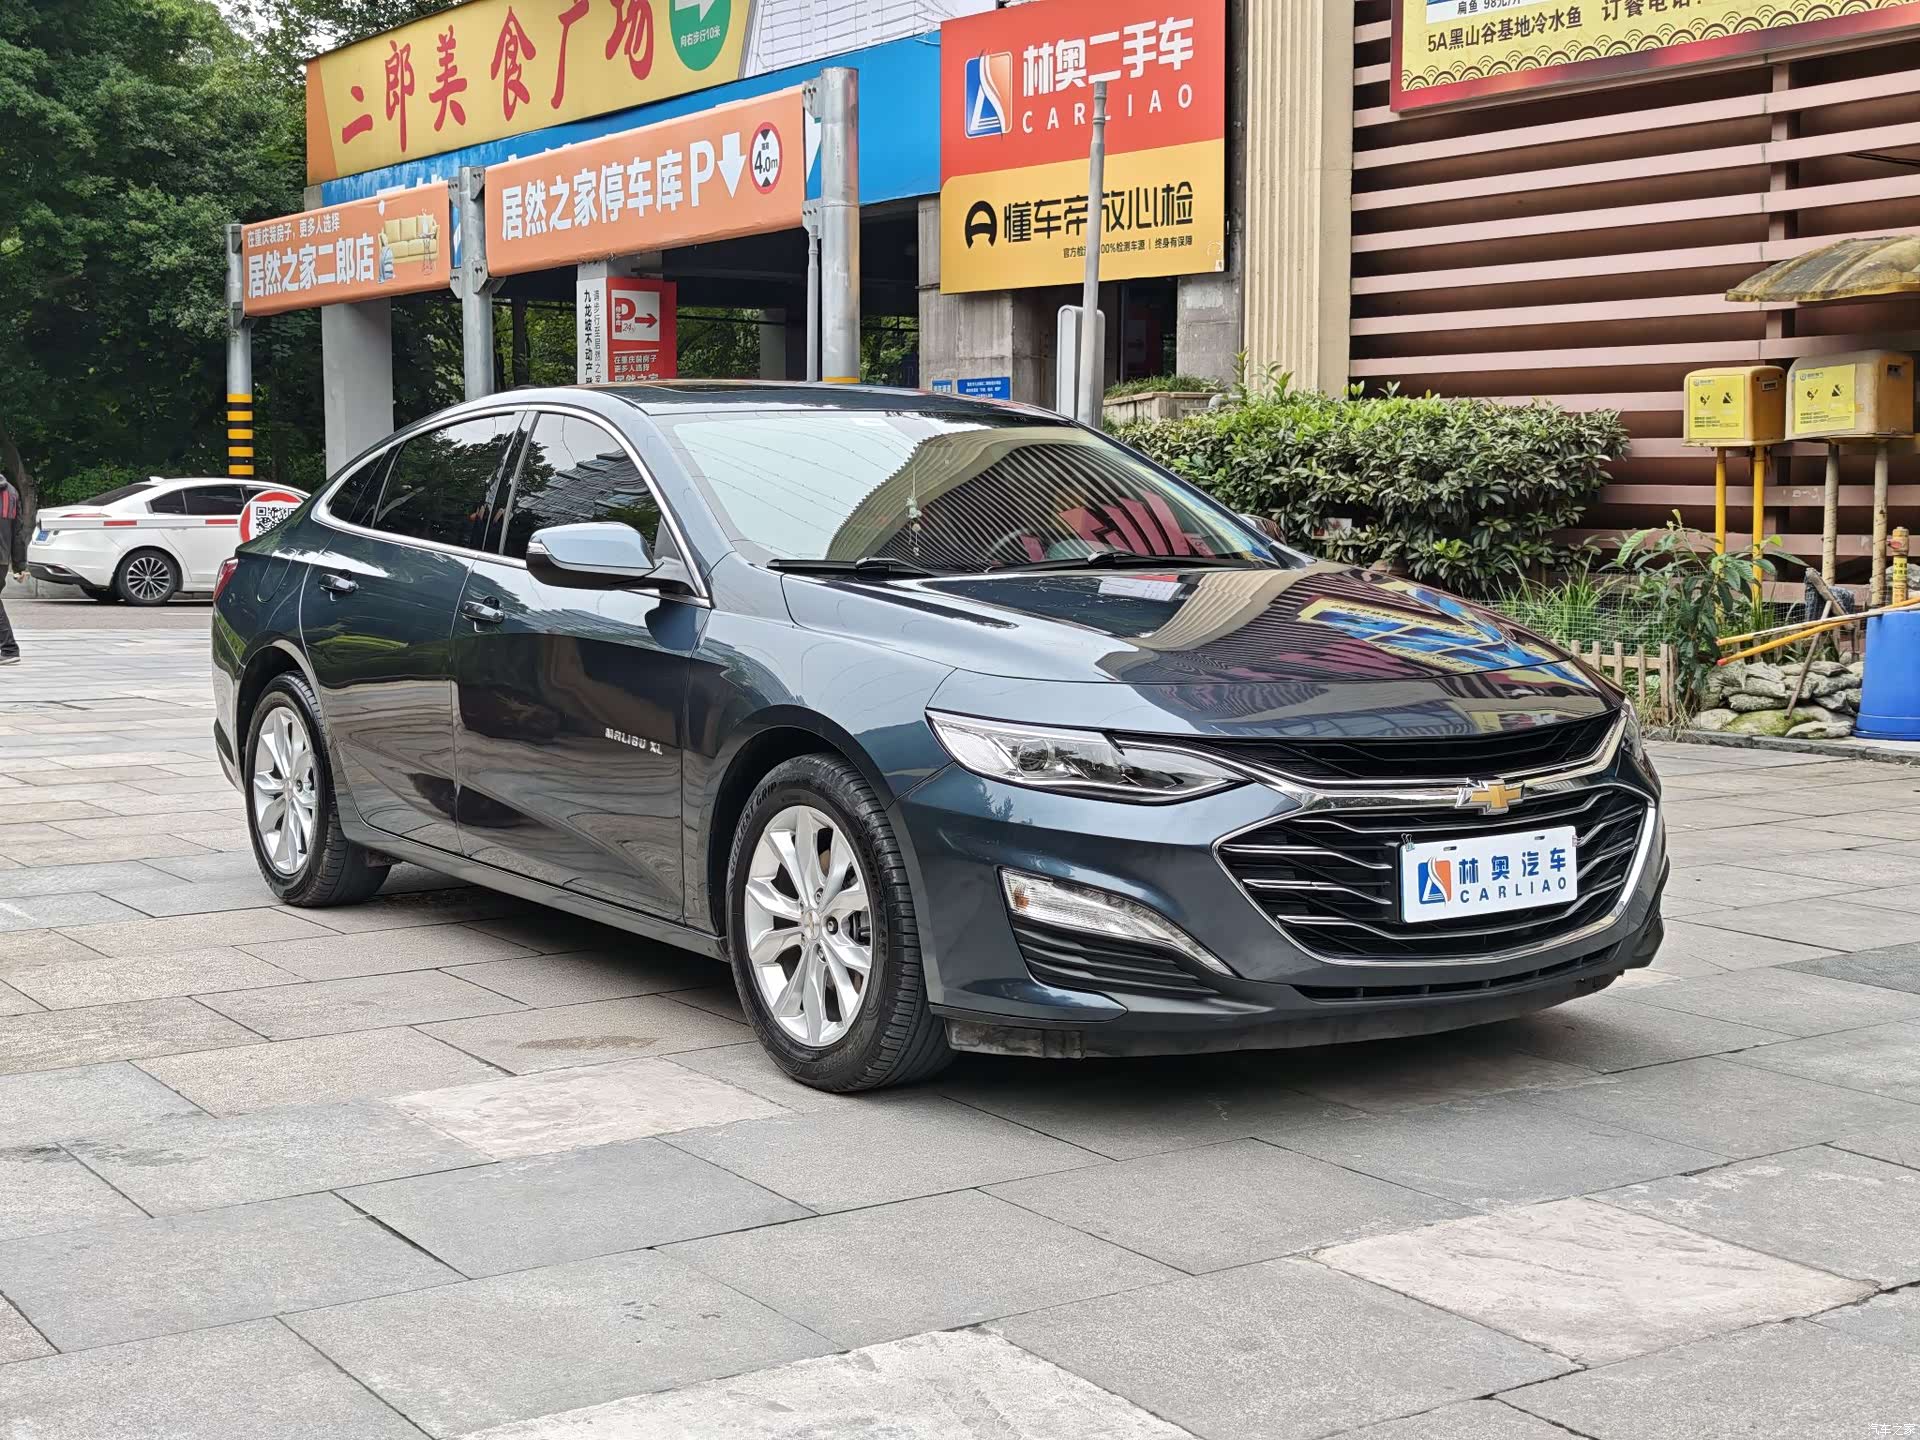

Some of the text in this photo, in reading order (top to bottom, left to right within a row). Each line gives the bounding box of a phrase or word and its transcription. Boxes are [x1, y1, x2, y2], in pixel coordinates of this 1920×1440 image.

[680, 25, 721, 47] 向右步行10米
[1428, 6, 1583, 52] 5A黑山谷基地冷水鱼
[342, 0, 654, 152] 二郎美食广场
[1023, 17, 1194, 97] 林奥二手车
[1022, 84, 1193, 133] CARIAO
[754, 150, 778, 174] 4.0m
[248, 233, 375, 299] 居然之家二郎店
[605, 728, 663, 755] MALIBU XL
[1459, 847, 1567, 885] 林奥汽车
[1460, 877, 1567, 904] CARLIAO
